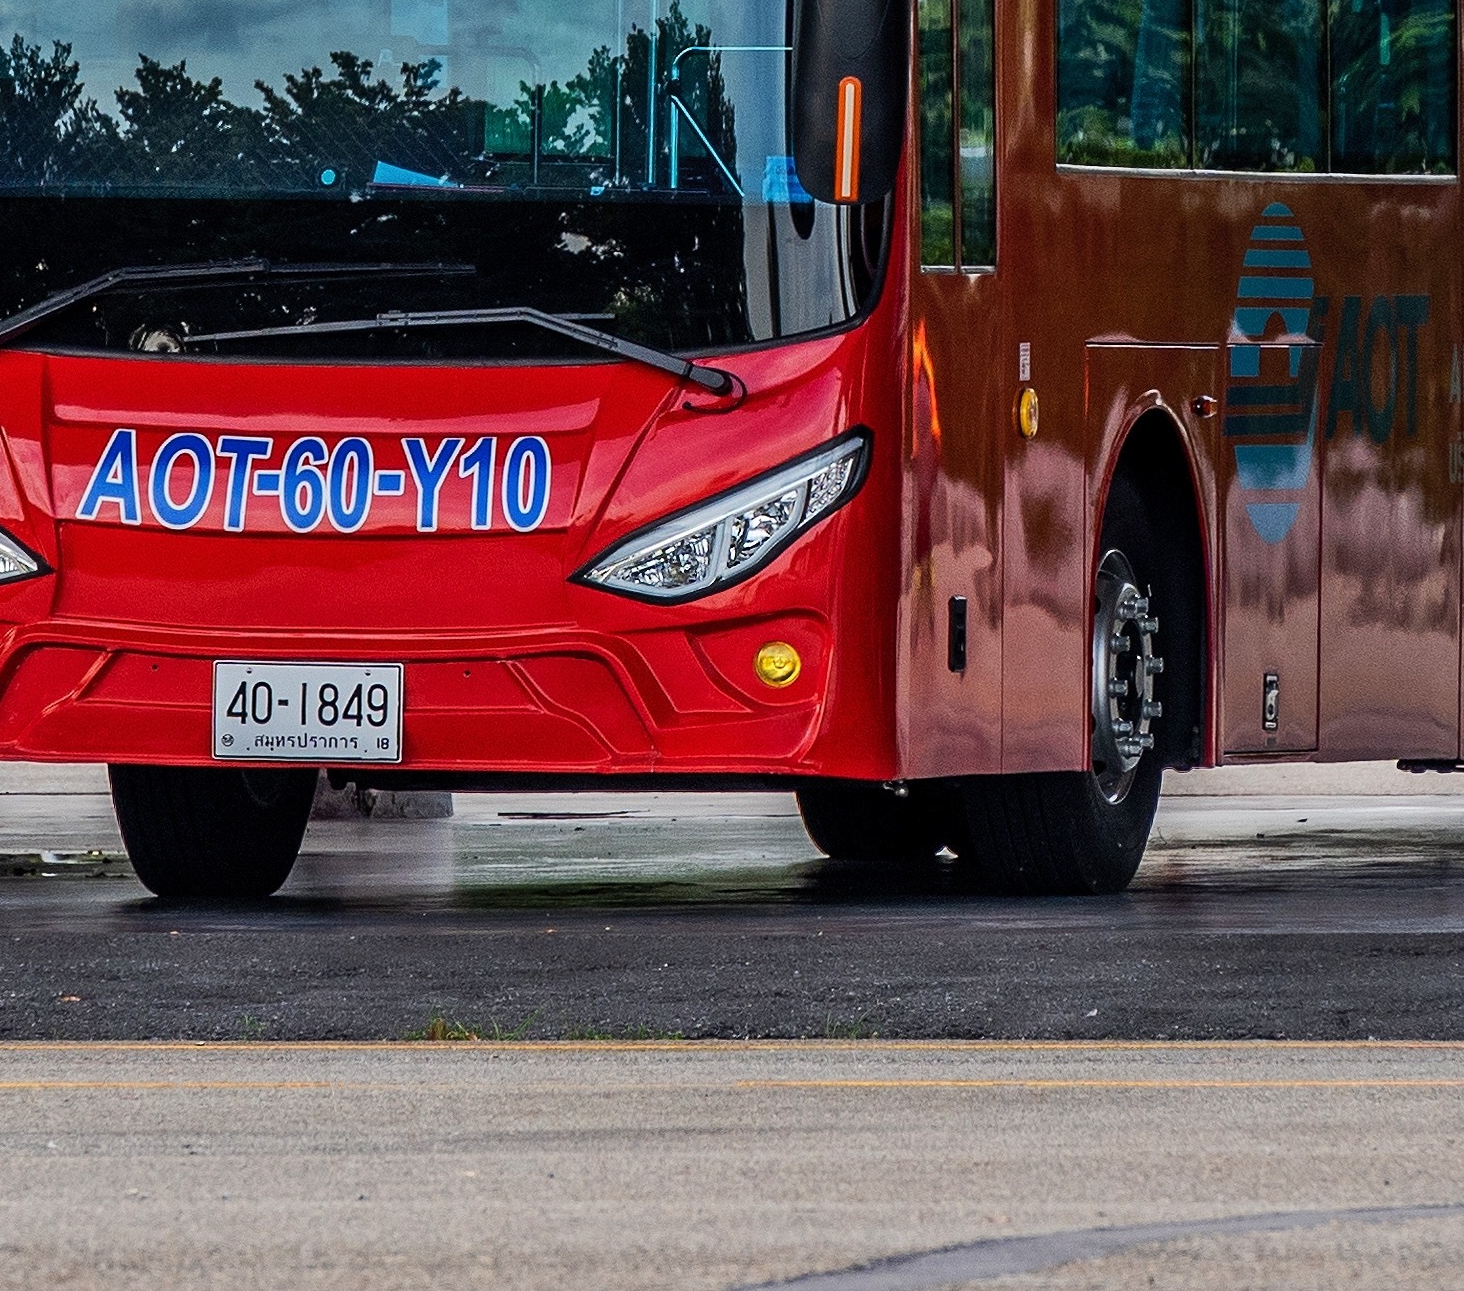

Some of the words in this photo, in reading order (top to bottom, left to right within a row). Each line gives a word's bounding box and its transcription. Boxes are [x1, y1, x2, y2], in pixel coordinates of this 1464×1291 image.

[1324, 293, 1432, 445] AOT
[75, 428, 553, 534] AOT-60-Y10
[226, 681, 389, 728] 40-1849
[254, 733, 359, 752] สมุทรปราการ
[376, 737, 390, 750] 18
